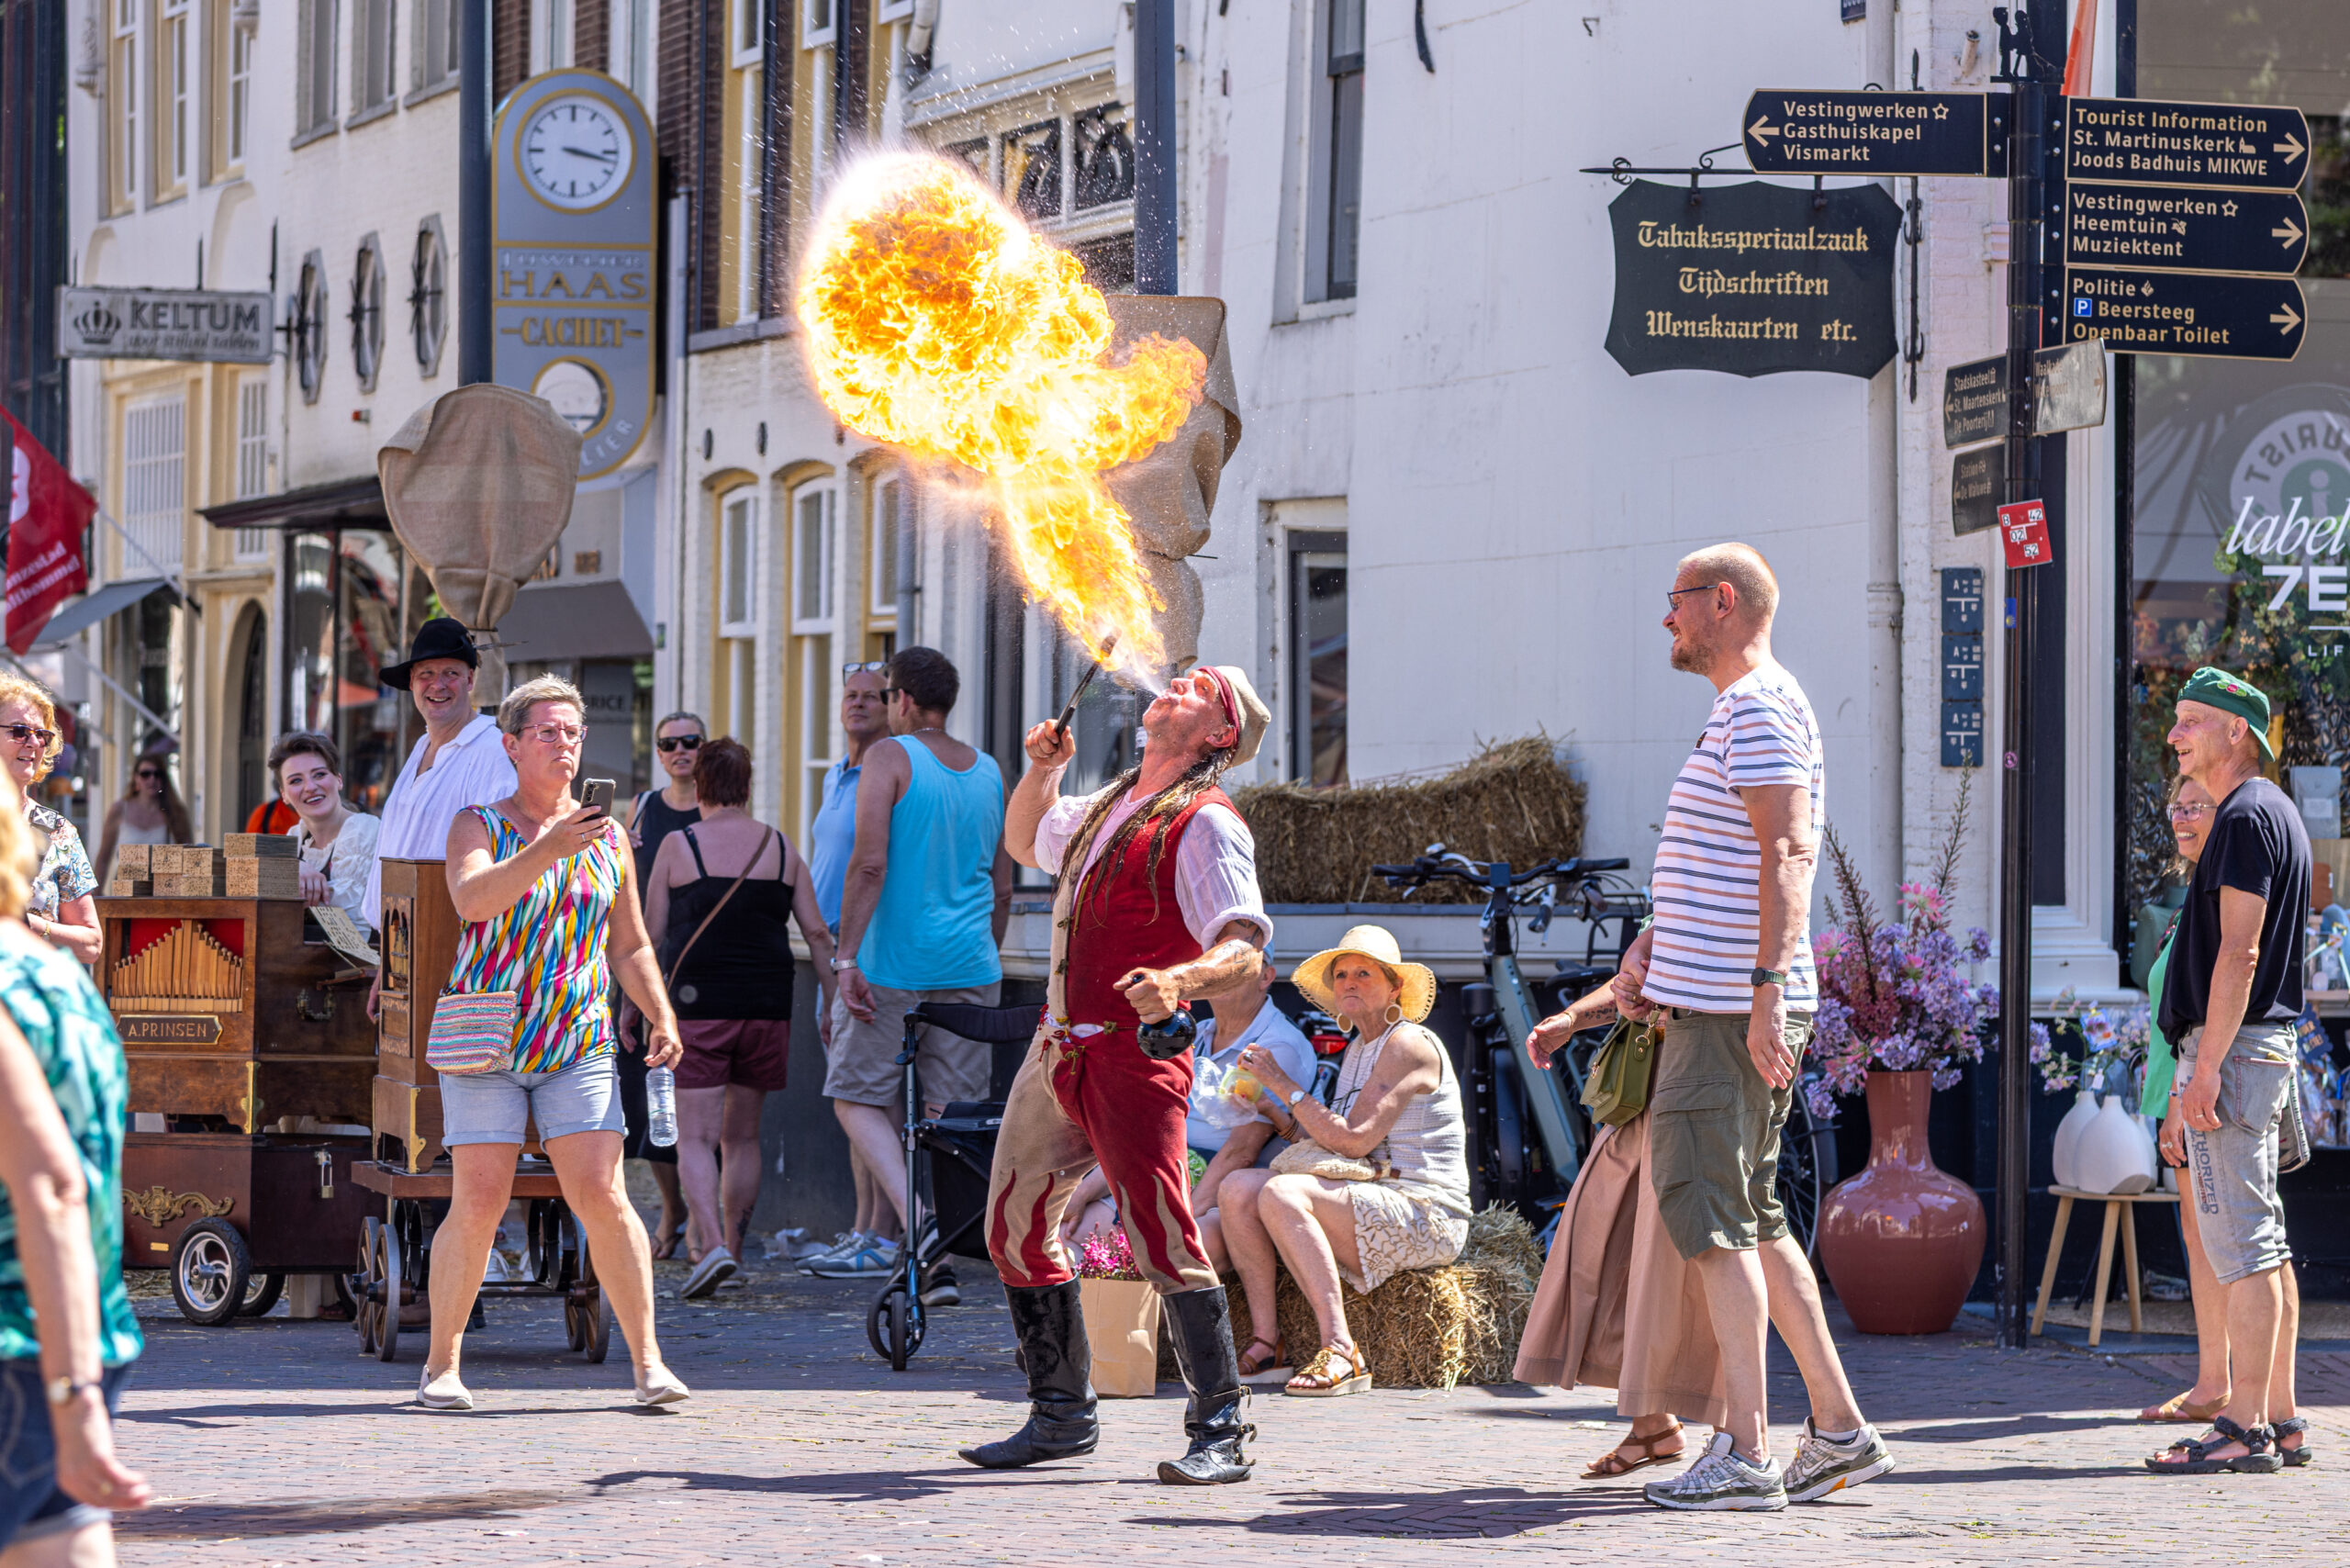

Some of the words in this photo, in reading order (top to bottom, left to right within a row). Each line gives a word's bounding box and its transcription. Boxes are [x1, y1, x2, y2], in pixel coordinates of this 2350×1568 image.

[1784, 101, 1929, 122] Vestingwerken
[2076, 107, 2145, 127] Tourist
[2152, 111, 2267, 132] Information
[1784, 122, 1921, 144] Gasthuiskapel
[2073, 129, 2098, 147] St.
[2105, 130, 2235, 153] Martinuskerk
[1784, 144, 1870, 162] Vismarkt
[2073, 151, 2124, 169] Joods
[2131, 153, 2201, 173] Badhuis
[2208, 157, 2267, 175] MIKWE
[2074, 193, 2217, 216] Vestingwerken
[2074, 214, 2167, 234] Heemtuin
[1638, 220, 1869, 255] Tabaksspeciaalzaak
[2073, 236, 2183, 257] Muziektent
[501, 270, 646, 299] HAAS
[1679, 267, 1829, 299] Tijdschriften
[2073, 278, 2136, 297] Politie
[129, 302, 261, 333] KELTUM
[2098, 301, 2195, 324] Beersteeg
[520, 318, 626, 348] CACHET
[1646, 310, 1798, 340] Wenskaarten
[1820, 319, 1857, 342] etc.
[2074, 323, 2168, 342] Openbaar
[2173, 326, 2230, 344] Toilet
[1954, 371, 1991, 393] Stadskasteel
[1963, 389, 2001, 410] Maartenskerk
[1954, 420, 1962, 433] De
[2029, 509, 2043, 521] 42
[2225, 495, 2350, 556] label
[2010, 530, 2024, 542] 02
[2024, 543, 2038, 556] 52
[1953, 579, 1960, 590] A
[1953, 646, 1960, 657] A
[1953, 712, 1959, 724] A
